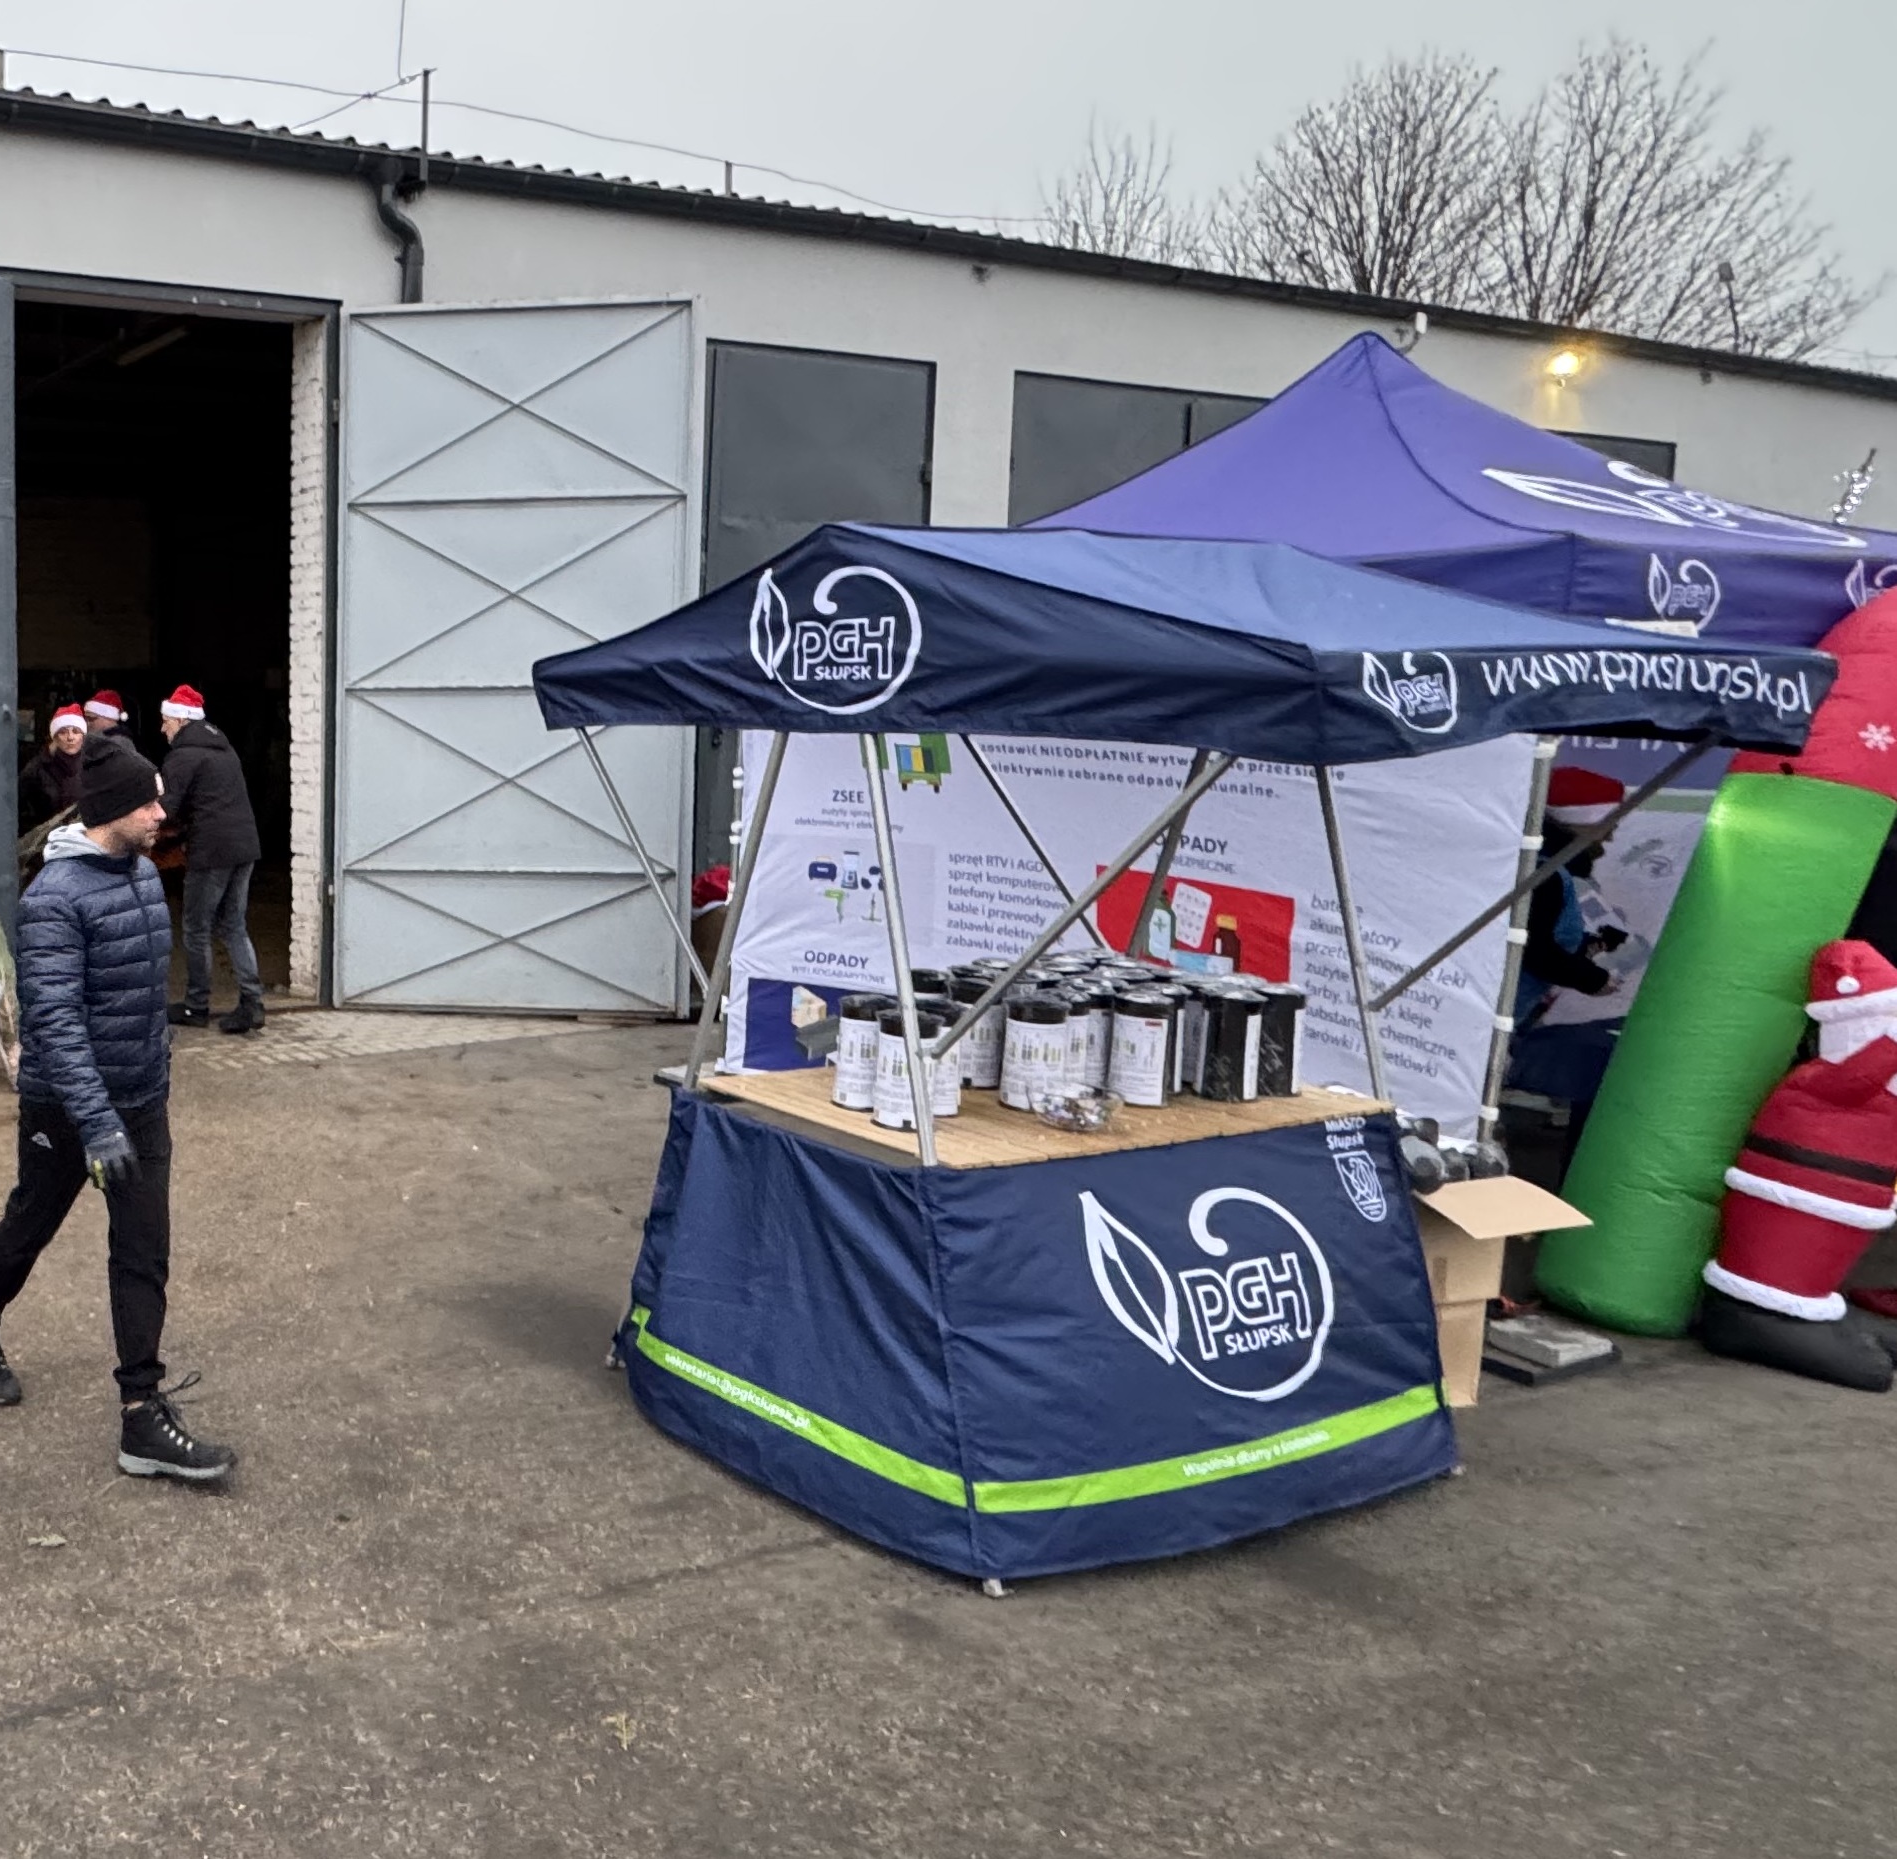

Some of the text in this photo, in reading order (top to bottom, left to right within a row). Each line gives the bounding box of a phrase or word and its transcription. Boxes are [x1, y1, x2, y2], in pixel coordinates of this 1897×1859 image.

[814, 665, 872, 681] SŁUPSK
[1040, 745, 1145, 763] NIEODPŁATNIE
[1295, 765, 1345, 780] sieie
[991, 763, 1065, 777] elektywnie
[1067, 768, 1124, 783] zebrane
[1127, 773, 1183, 790] odpady
[832, 789, 865, 803] ZSEE
[1154, 834, 1228, 855] OPADY
[948, 853, 983, 867] sprzęt
[986, 855, 1008, 868] RTV
[1017, 859, 1044, 872] AGD
[948, 869, 1062, 892] sprzęt komputerow
[948, 884, 1068, 910] telefony komórkowe
[948, 901, 979, 915] kable
[987, 908, 1046, 927] przewody
[947, 919, 994, 933] zabawki
[1309, 918, 1401, 950] akumatory
[946, 935, 993, 951] zabawki
[804, 949, 869, 969] ODPADY
[1403, 988, 1442, 1012] mary
[1379, 1024, 1457, 1060] chemiczne
[1324, 1117, 1366, 1132] MIASTO
[1224, 1323, 1294, 1355] SŁUPSK
